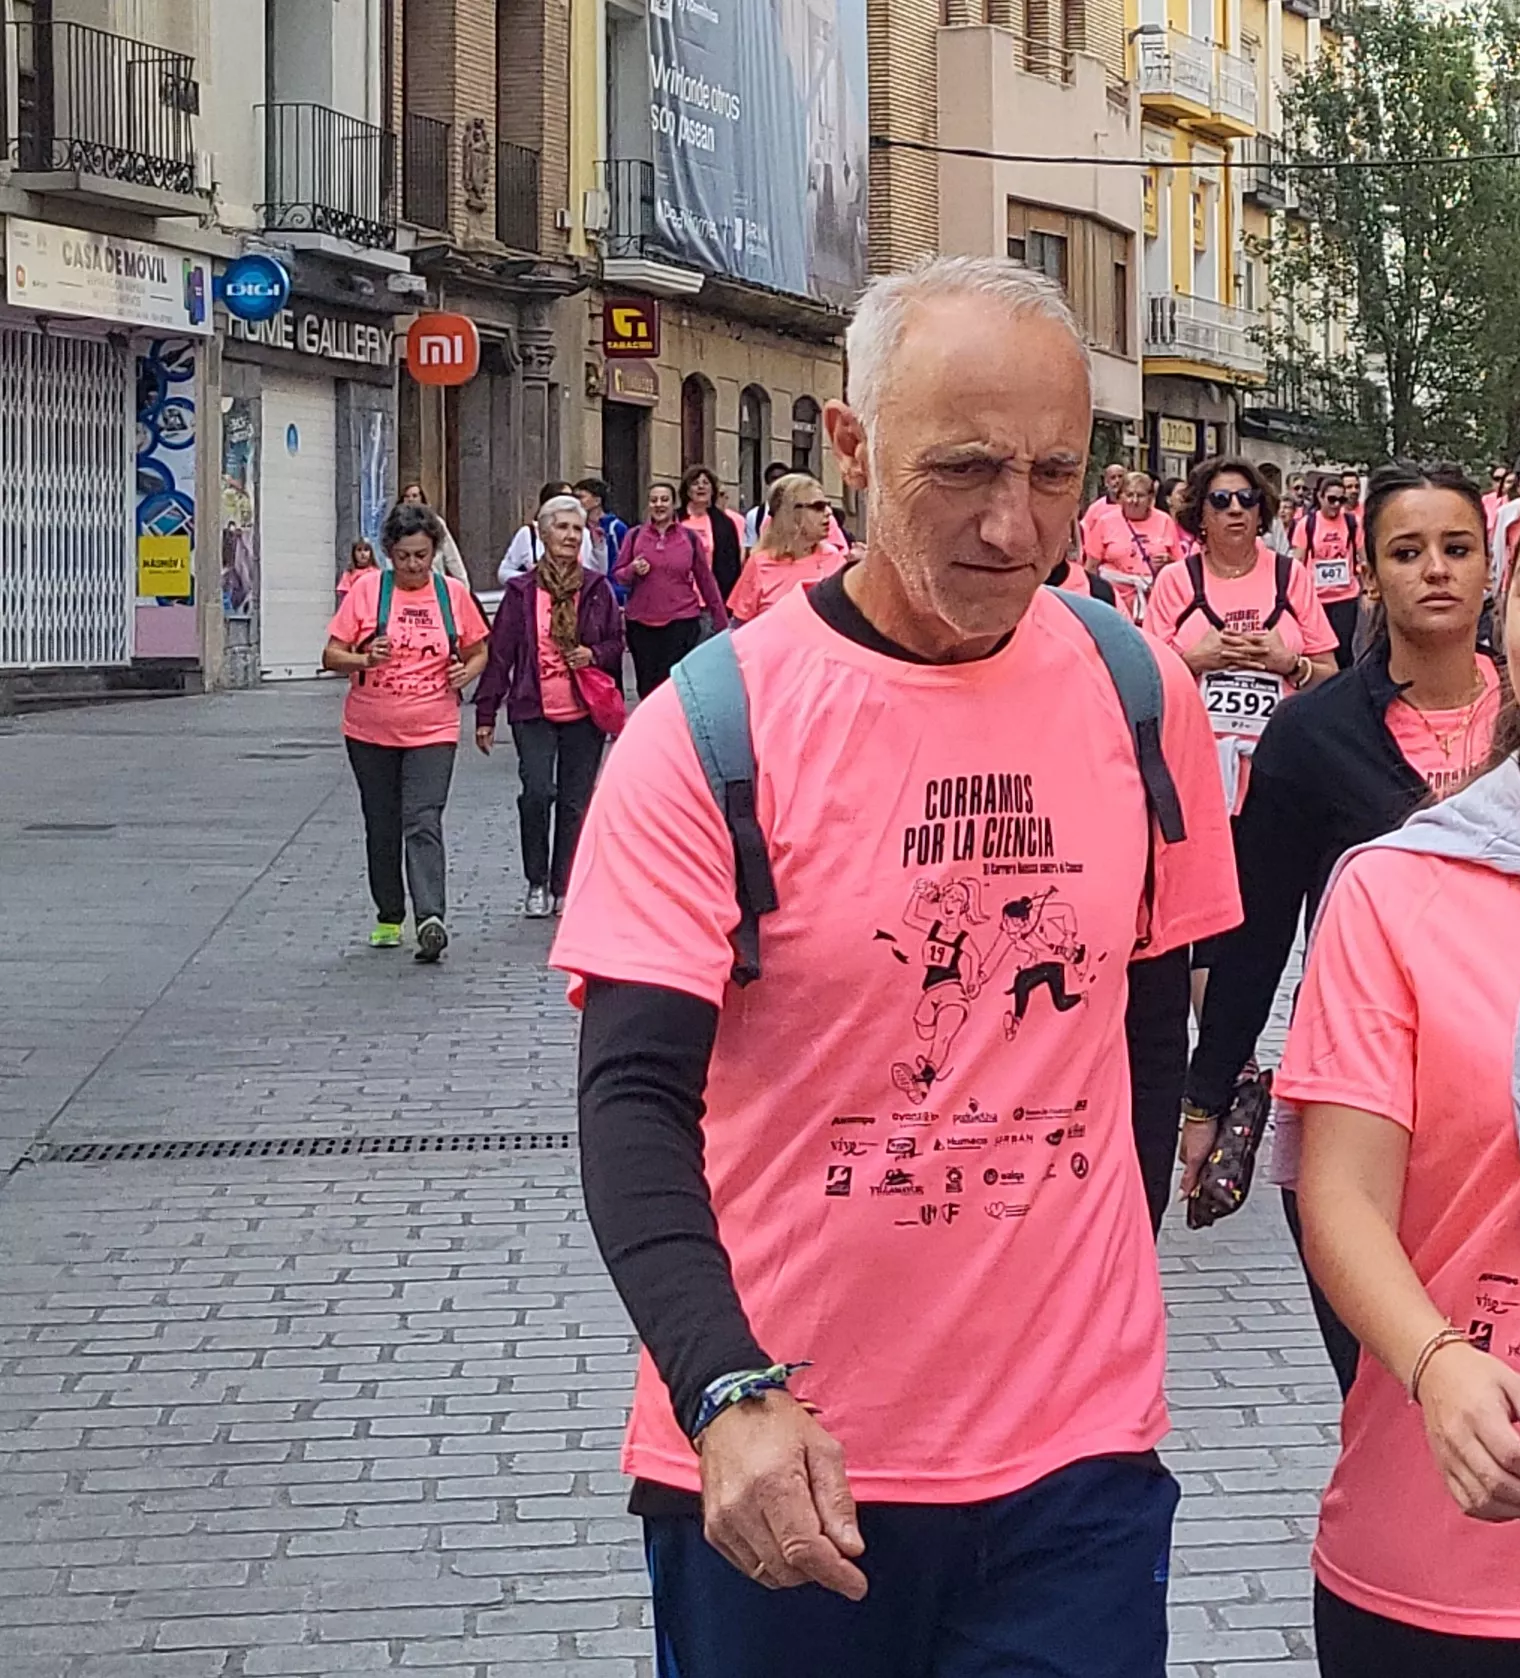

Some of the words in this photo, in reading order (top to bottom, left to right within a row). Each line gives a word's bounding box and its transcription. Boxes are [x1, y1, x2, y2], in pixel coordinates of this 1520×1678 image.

[62, 240, 102, 272] CASA
[104, 247, 121, 275] DE
[124, 246, 167, 283] MÓVIL
[226, 283, 280, 296] DIGI
[304, 313, 394, 366] GALLERY
[1208, 691, 1275, 717] 2592
[925, 773, 1034, 820] CORRAMOS
[902, 823, 946, 869] POR
[953, 818, 975, 861] LA
[982, 816, 1054, 858] CIENCIA
